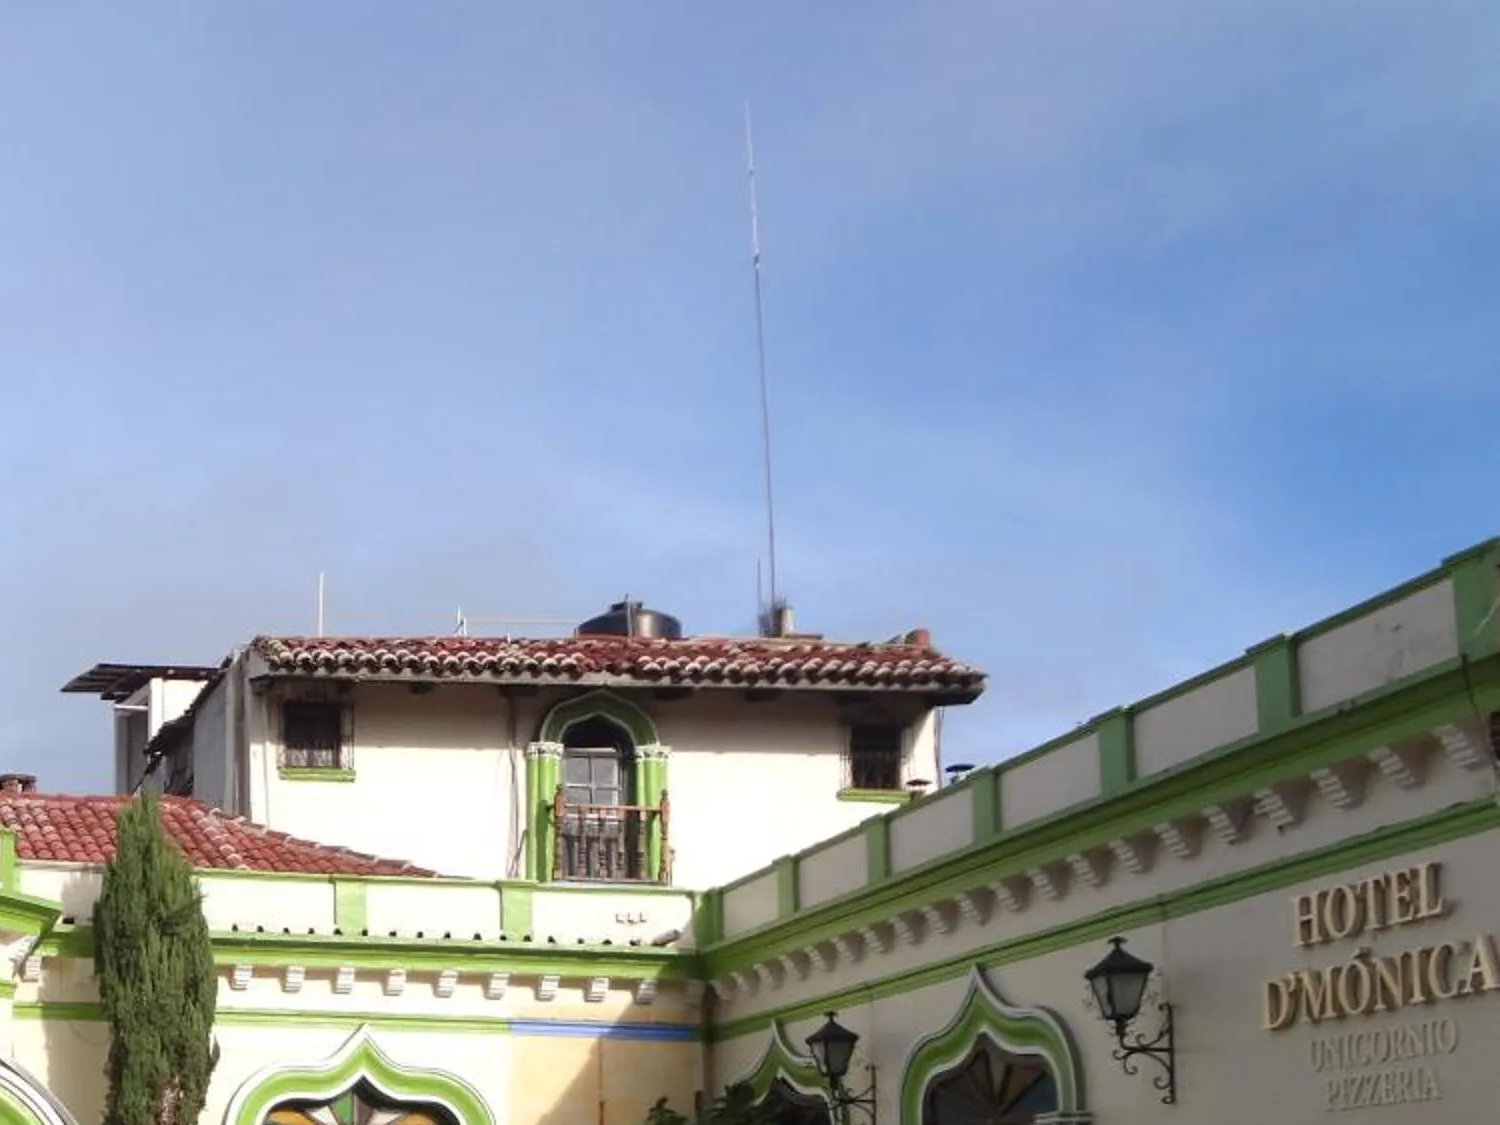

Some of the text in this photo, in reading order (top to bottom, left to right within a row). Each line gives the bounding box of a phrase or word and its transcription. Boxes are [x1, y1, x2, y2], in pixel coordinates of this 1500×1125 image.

[1291, 861, 1446, 947] HOTEL
[1310, 1018, 1460, 1073] UNICORNIO
[1326, 1066, 1445, 1112] PIZZERIA
